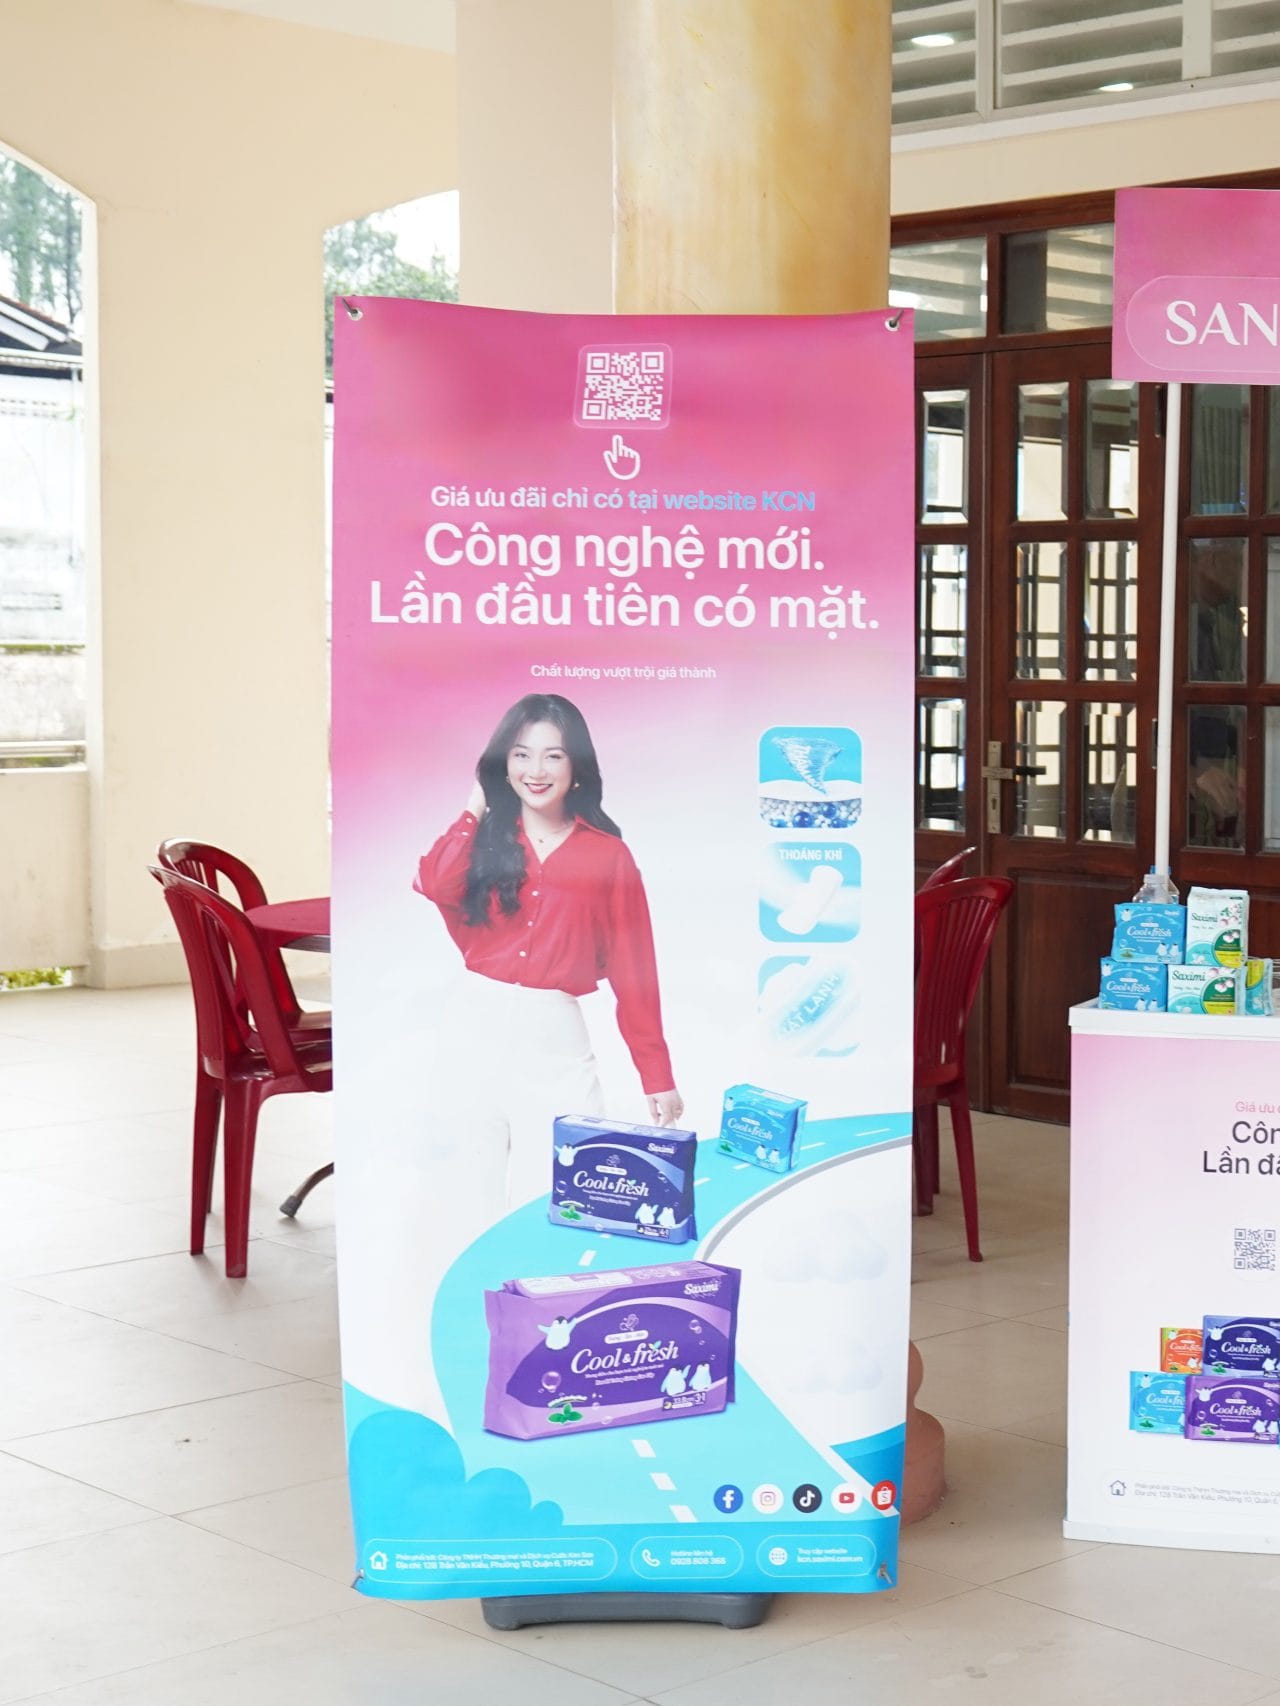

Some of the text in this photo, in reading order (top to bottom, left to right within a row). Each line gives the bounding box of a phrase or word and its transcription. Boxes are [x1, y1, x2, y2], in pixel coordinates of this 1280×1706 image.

[431, 485, 816, 514] Giá ưu đãi chỉ có tại website KCN
[424, 521, 825, 580] Công nghệ mới.
[370, 571, 880, 639] Lần đầu tiên có mặt.
[530, 662, 716, 681] Chất lượng vượt trội giá thành
[778, 847, 842, 861] THOÁNG KHÍ
[1171, 971, 1206, 982] Saximi
[1235, 1101, 1256, 1113] Giá
[1259, 1104, 1275, 1113] ưu
[1203, 1146, 1250, 1175] Lần
[570, 1340, 679, 1374] Cool&fresh
